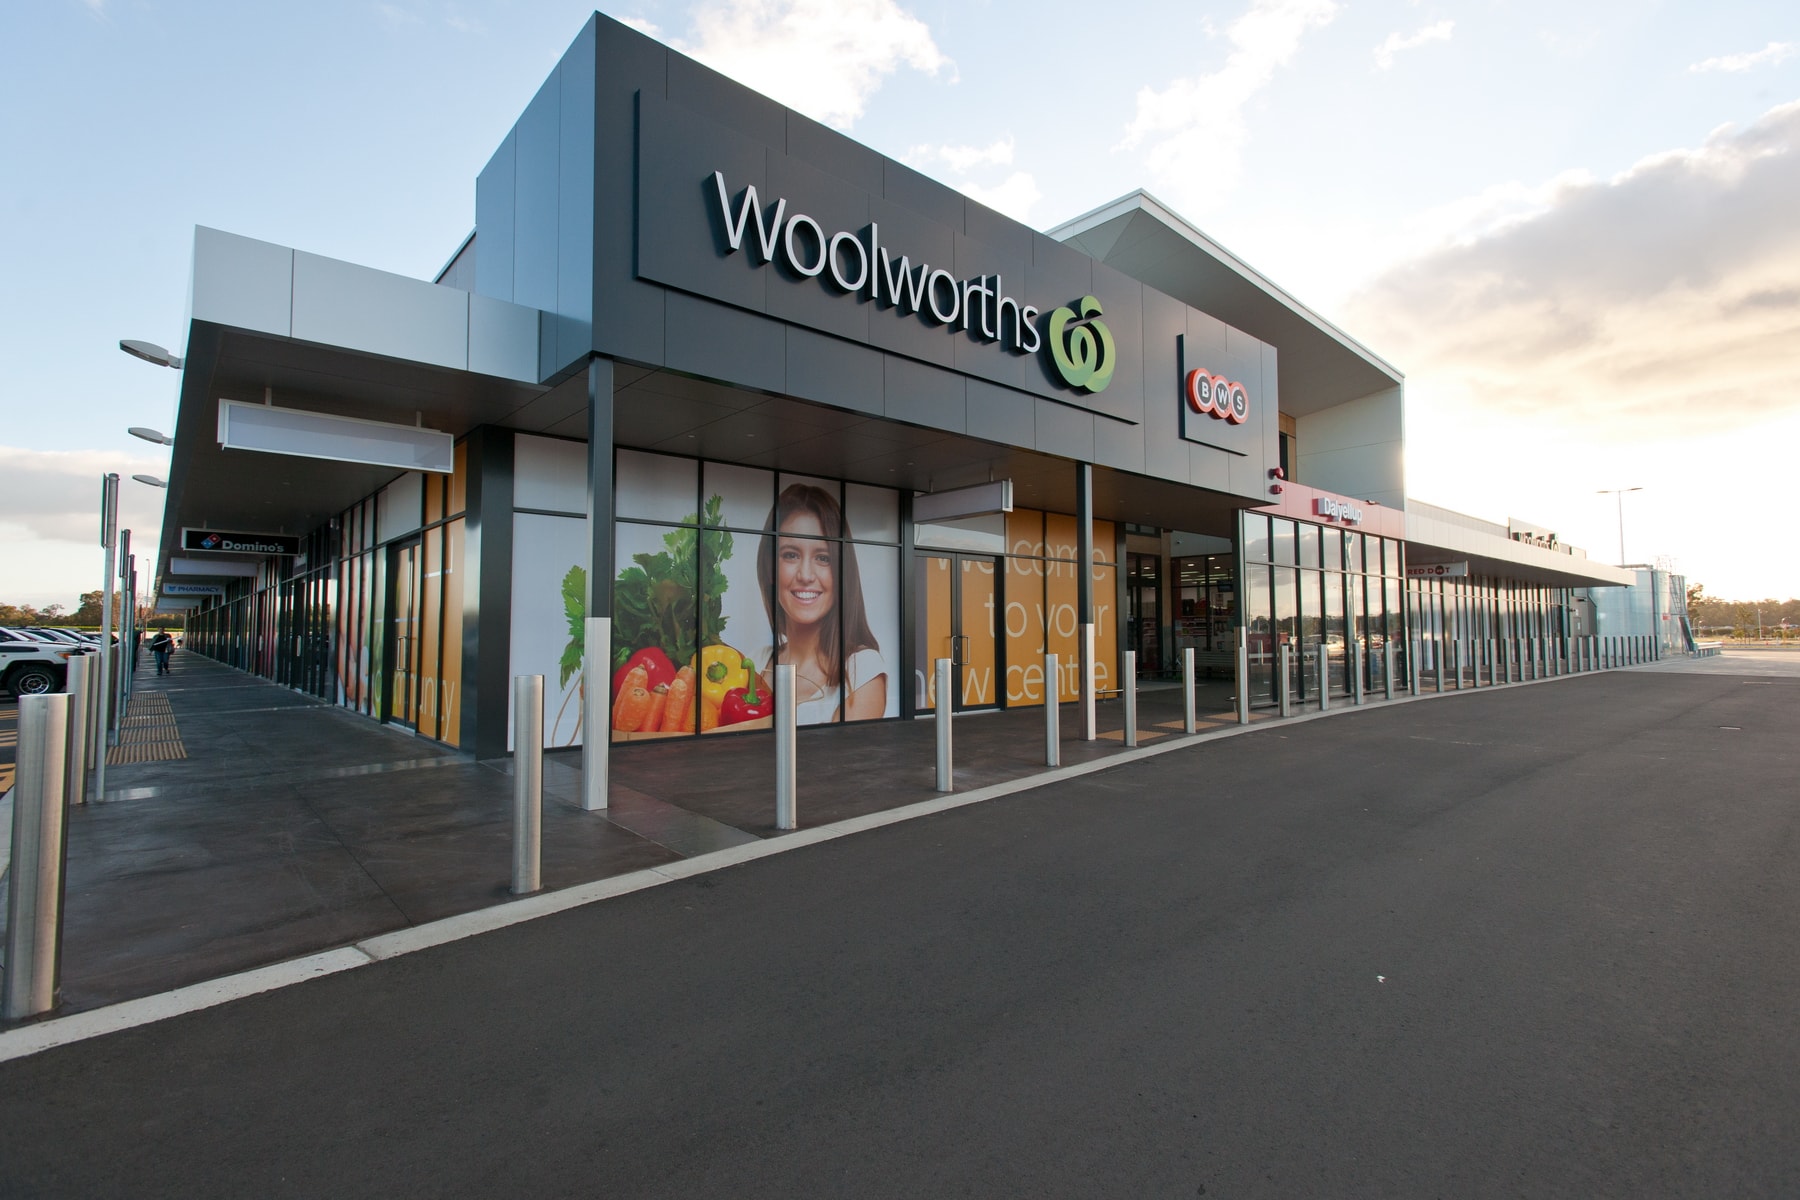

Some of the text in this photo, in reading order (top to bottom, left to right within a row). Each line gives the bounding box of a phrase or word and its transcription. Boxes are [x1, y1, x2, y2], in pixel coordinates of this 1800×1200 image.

[714, 170, 1041, 353] Woolworths
[1322, 497, 1363, 525] Dalyellup
[222, 540, 285, 553] Domino's
[1407, 567, 1425, 576] RED
[177, 585, 219, 593] PHARMACY
[984, 592, 1109, 654] to yor
